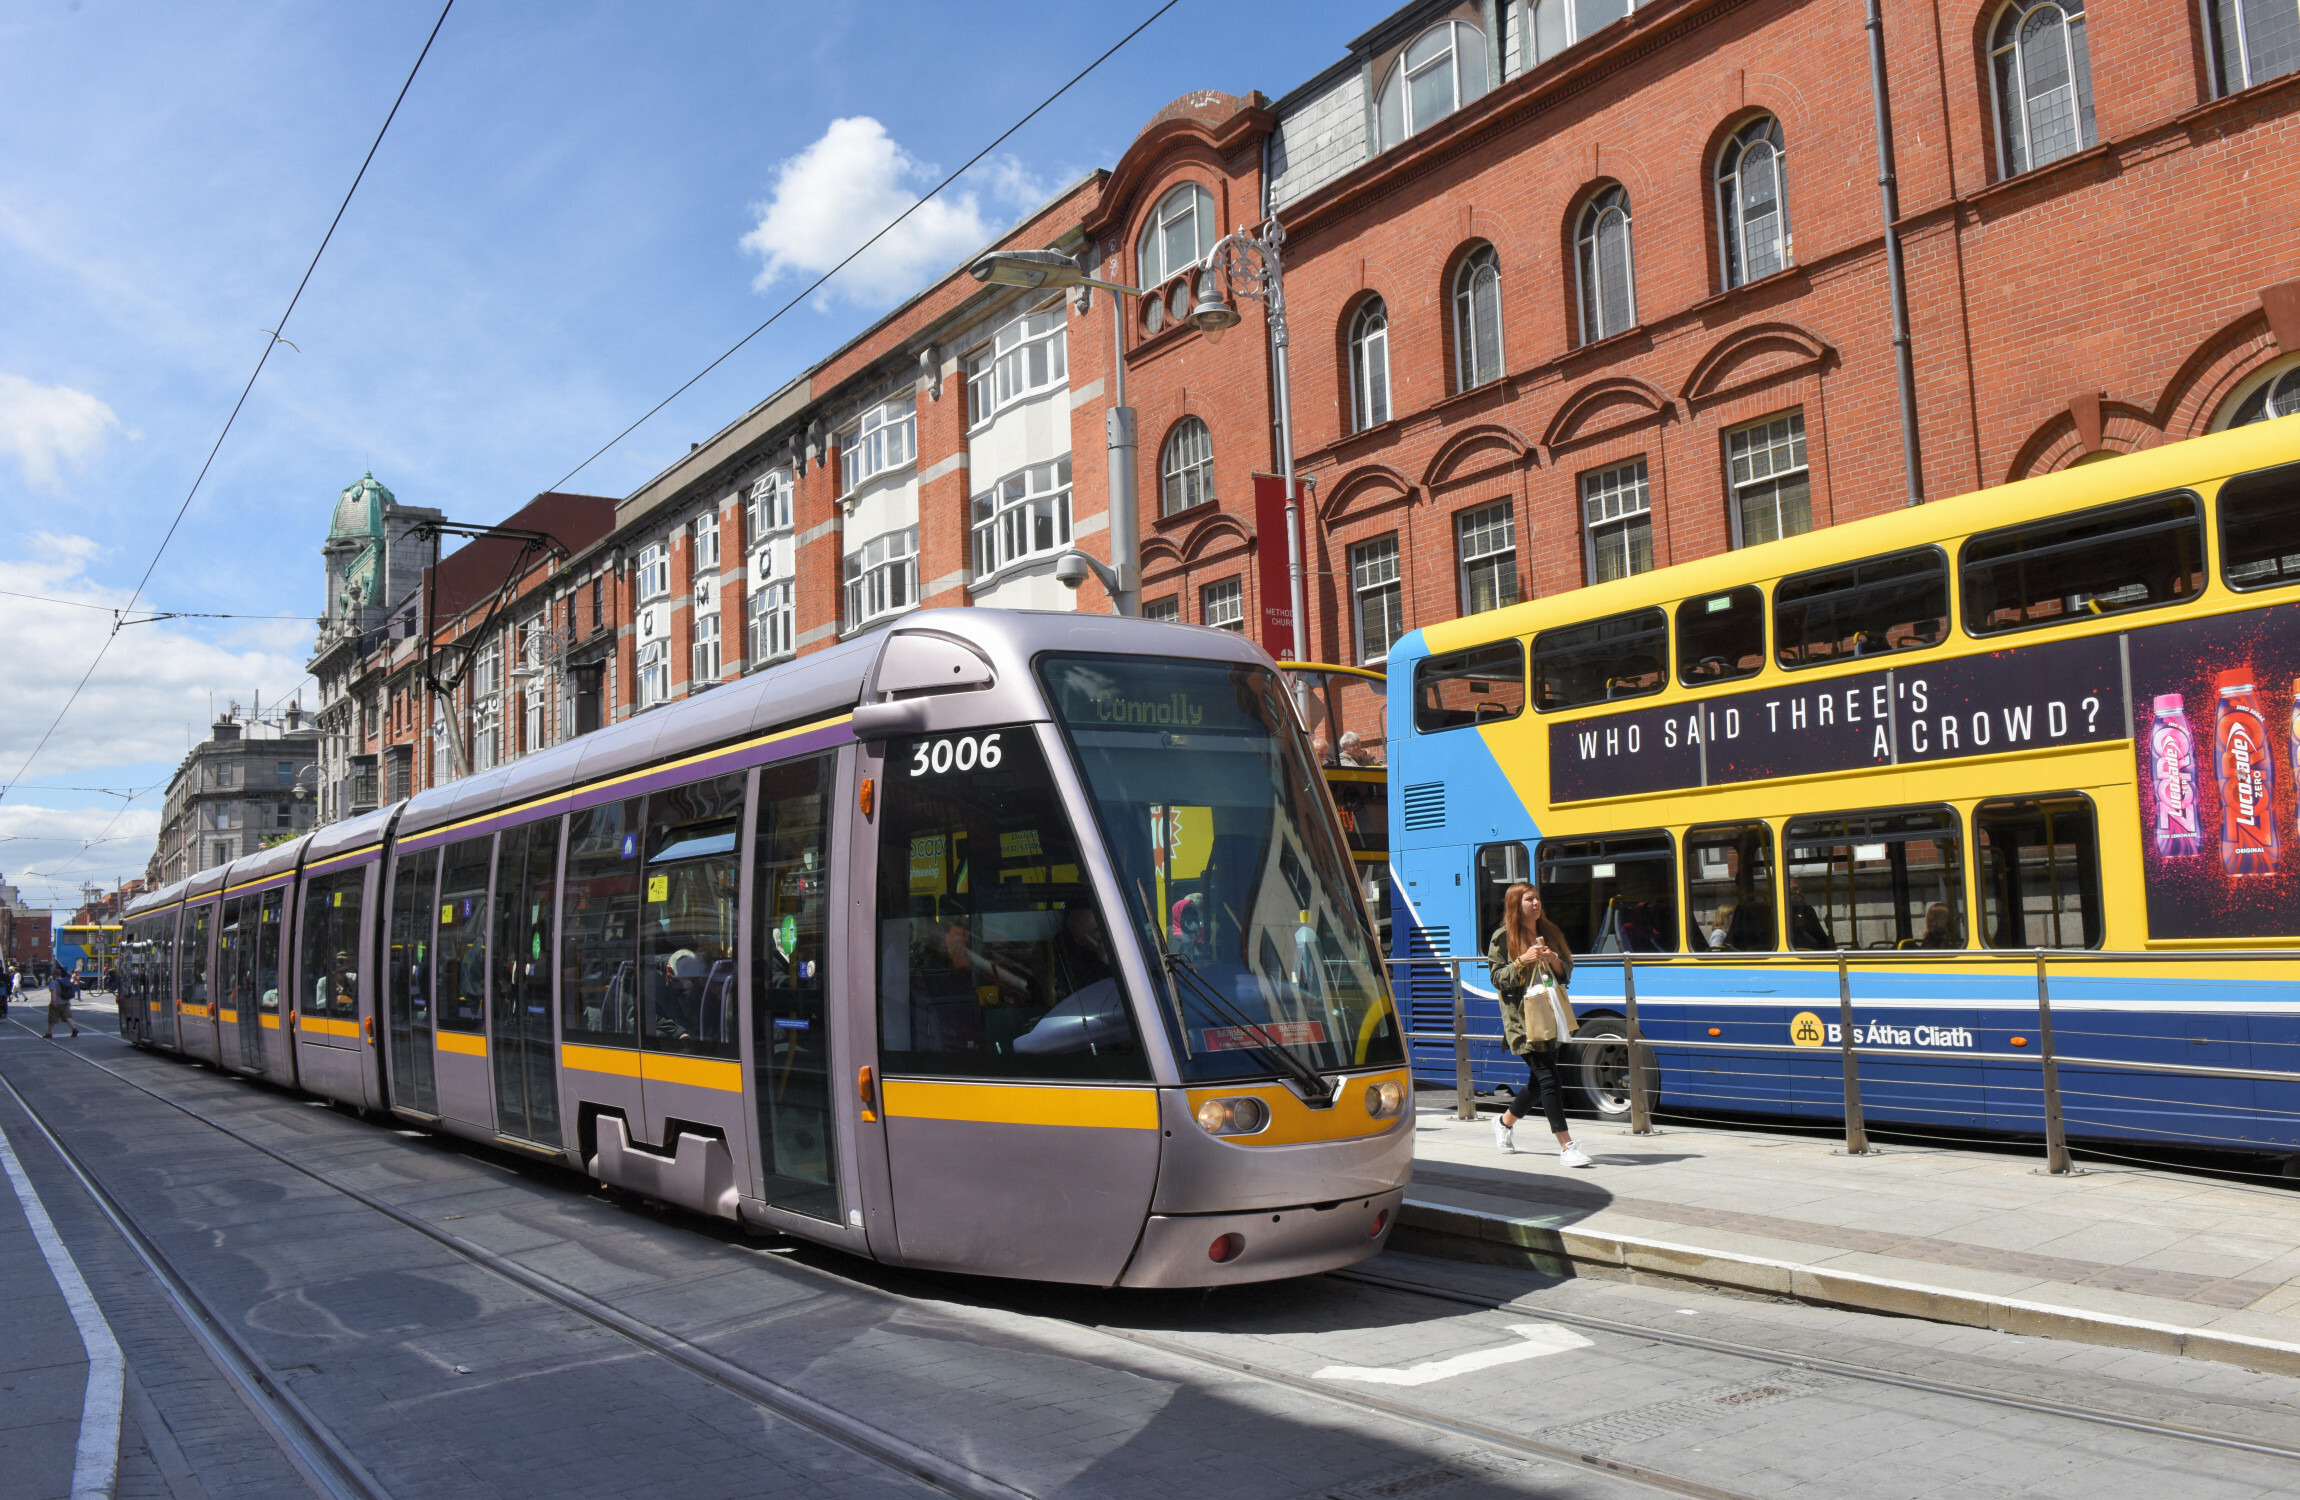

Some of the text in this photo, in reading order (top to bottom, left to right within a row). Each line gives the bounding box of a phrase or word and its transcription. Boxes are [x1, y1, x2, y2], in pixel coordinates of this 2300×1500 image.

[1097, 690, 1202, 725] Connolly
[1578, 680, 1928, 760] WHO SAID THREE'S
[1873, 697, 2100, 758] A CROWD?
[910, 733, 1002, 777] 3006
[2168, 748, 2183, 817] Lucozade
[2254, 770, 2263, 798] ZERO
[1828, 1019, 1973, 1048] Bs Átha Cliath
